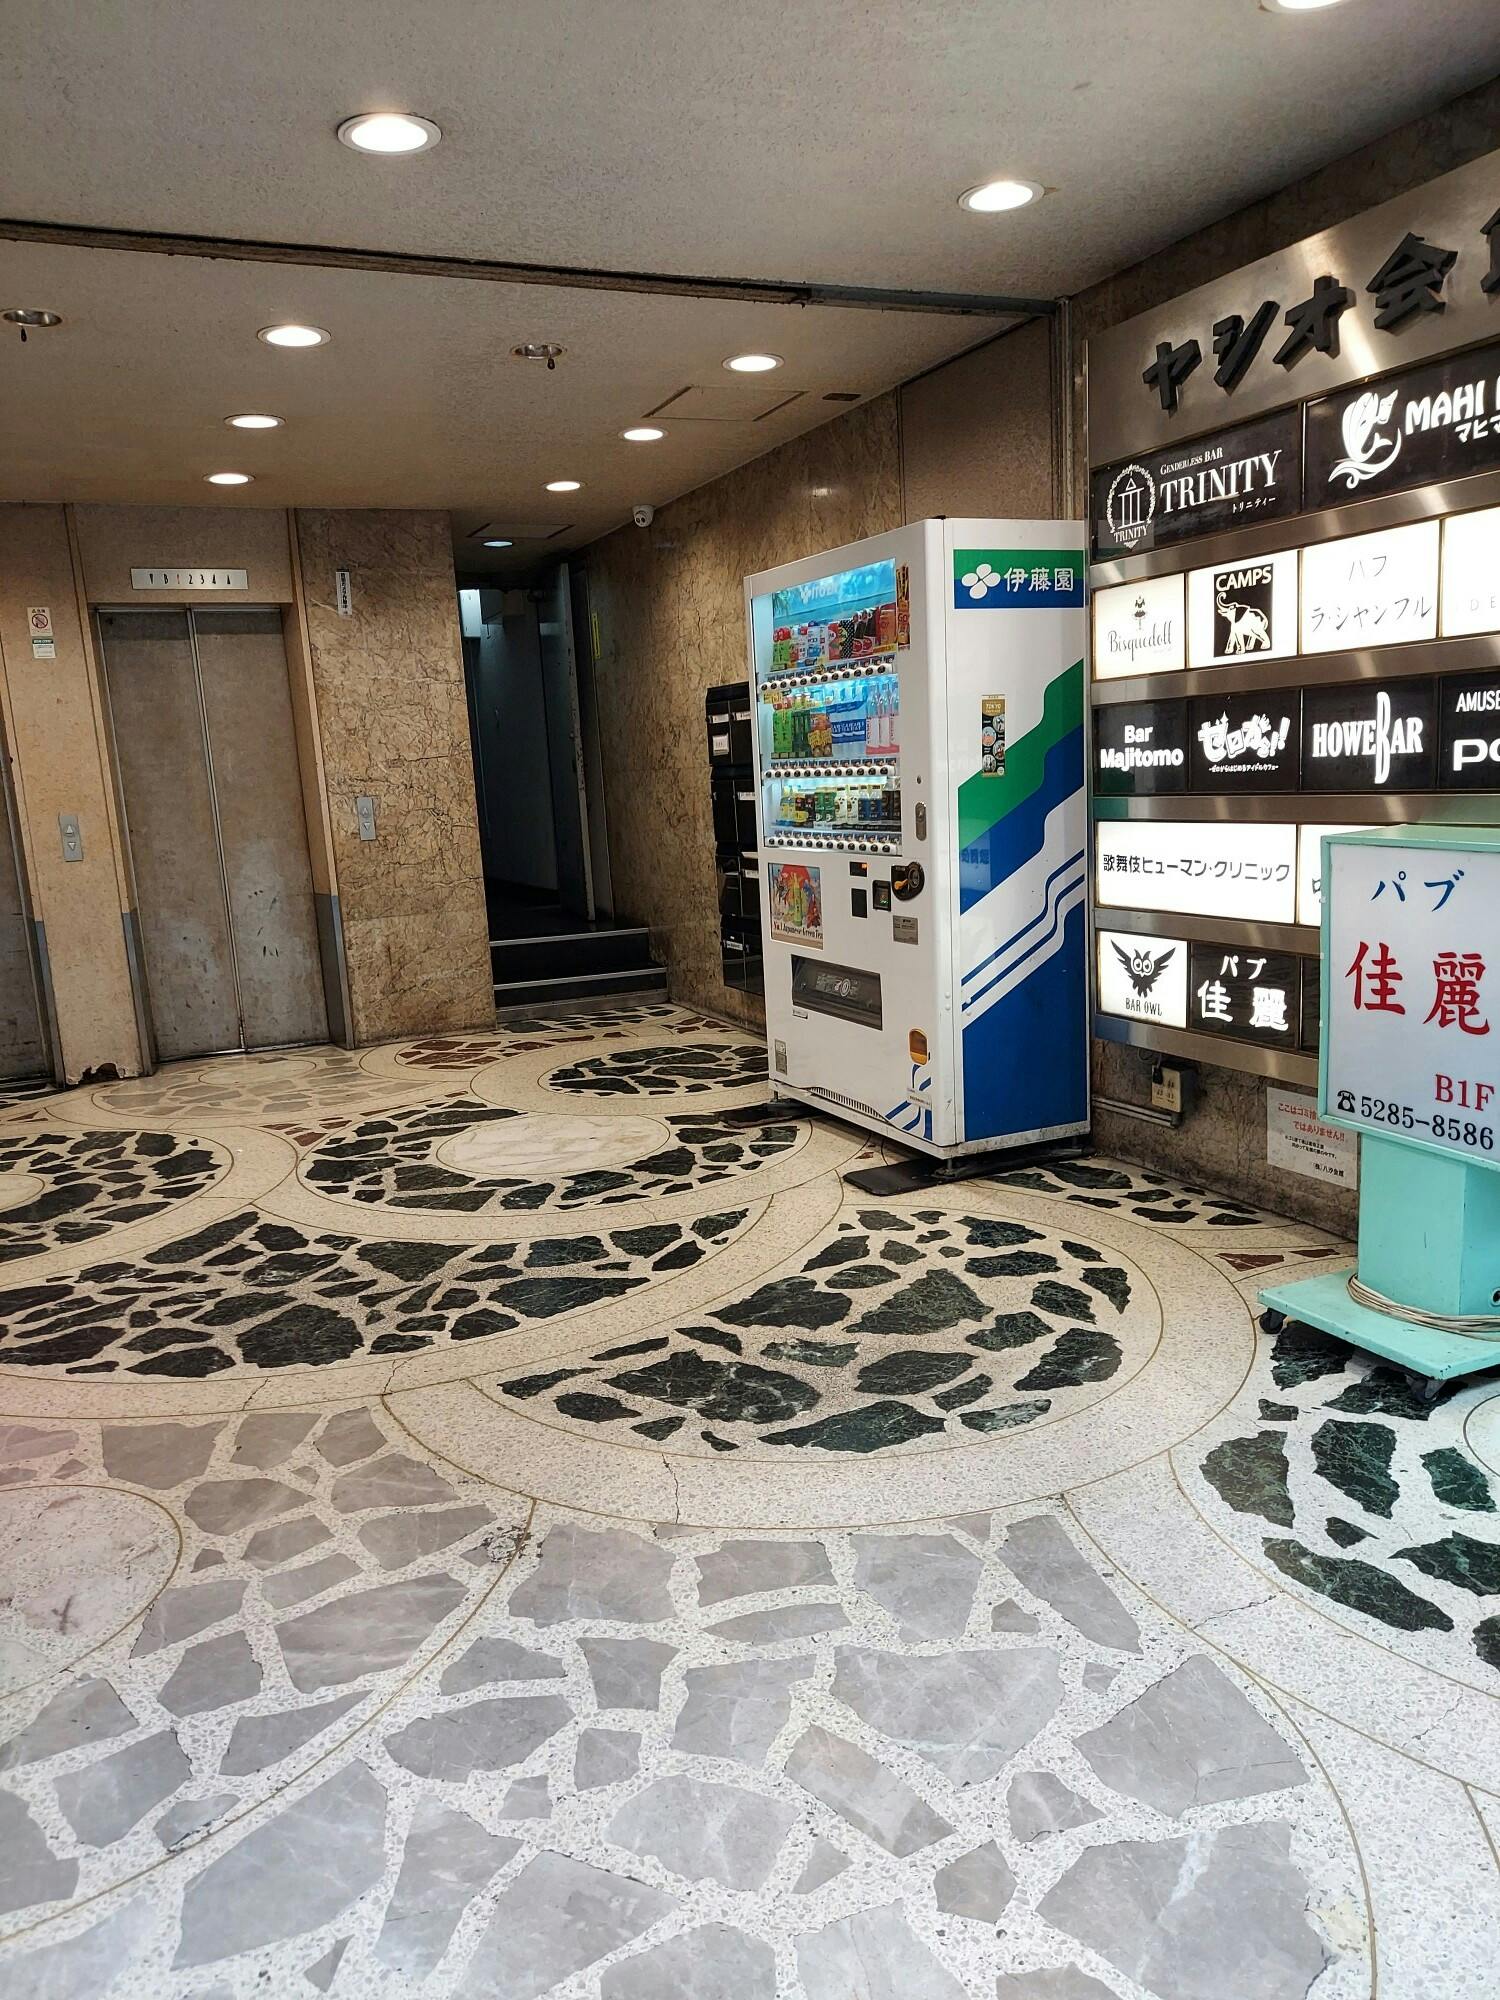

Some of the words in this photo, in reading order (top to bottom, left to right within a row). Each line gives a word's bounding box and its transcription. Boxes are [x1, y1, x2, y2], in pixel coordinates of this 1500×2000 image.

[1143, 205, 1500, 411] ヤシオ会
[1405, 379, 1486, 436] MAHI
[1204, 446, 1224, 463] BAR
[1159, 449, 1283, 514] TRINITY
[1232, 497, 1276, 514] トリニティー
[1113, 524, 1149, 544] TRINITY
[188, 574, 194, 585] 2
[200, 574, 205, 585] 3
[1003, 566, 1075, 593] 伊藤園
[1215, 566, 1272, 592] CAMPS
[1124, 724, 1154, 744] Bar
[1100, 746, 1184, 772] Majitomo
[1102, 853, 1291, 882] 歌舞伎ヒューマン・クリニック
[1370, 868, 1465, 912] パブ
[1219, 954, 1268, 980] パブ
[1345, 941, 1490, 1036] 佳麗
[1125, 997, 1141, 1013] BAR
[1143, 1000, 1163, 1017] OWL
[1434, 1073, 1496, 1113] B1F
[1360, 1095, 1495, 1151] 5285-8586
